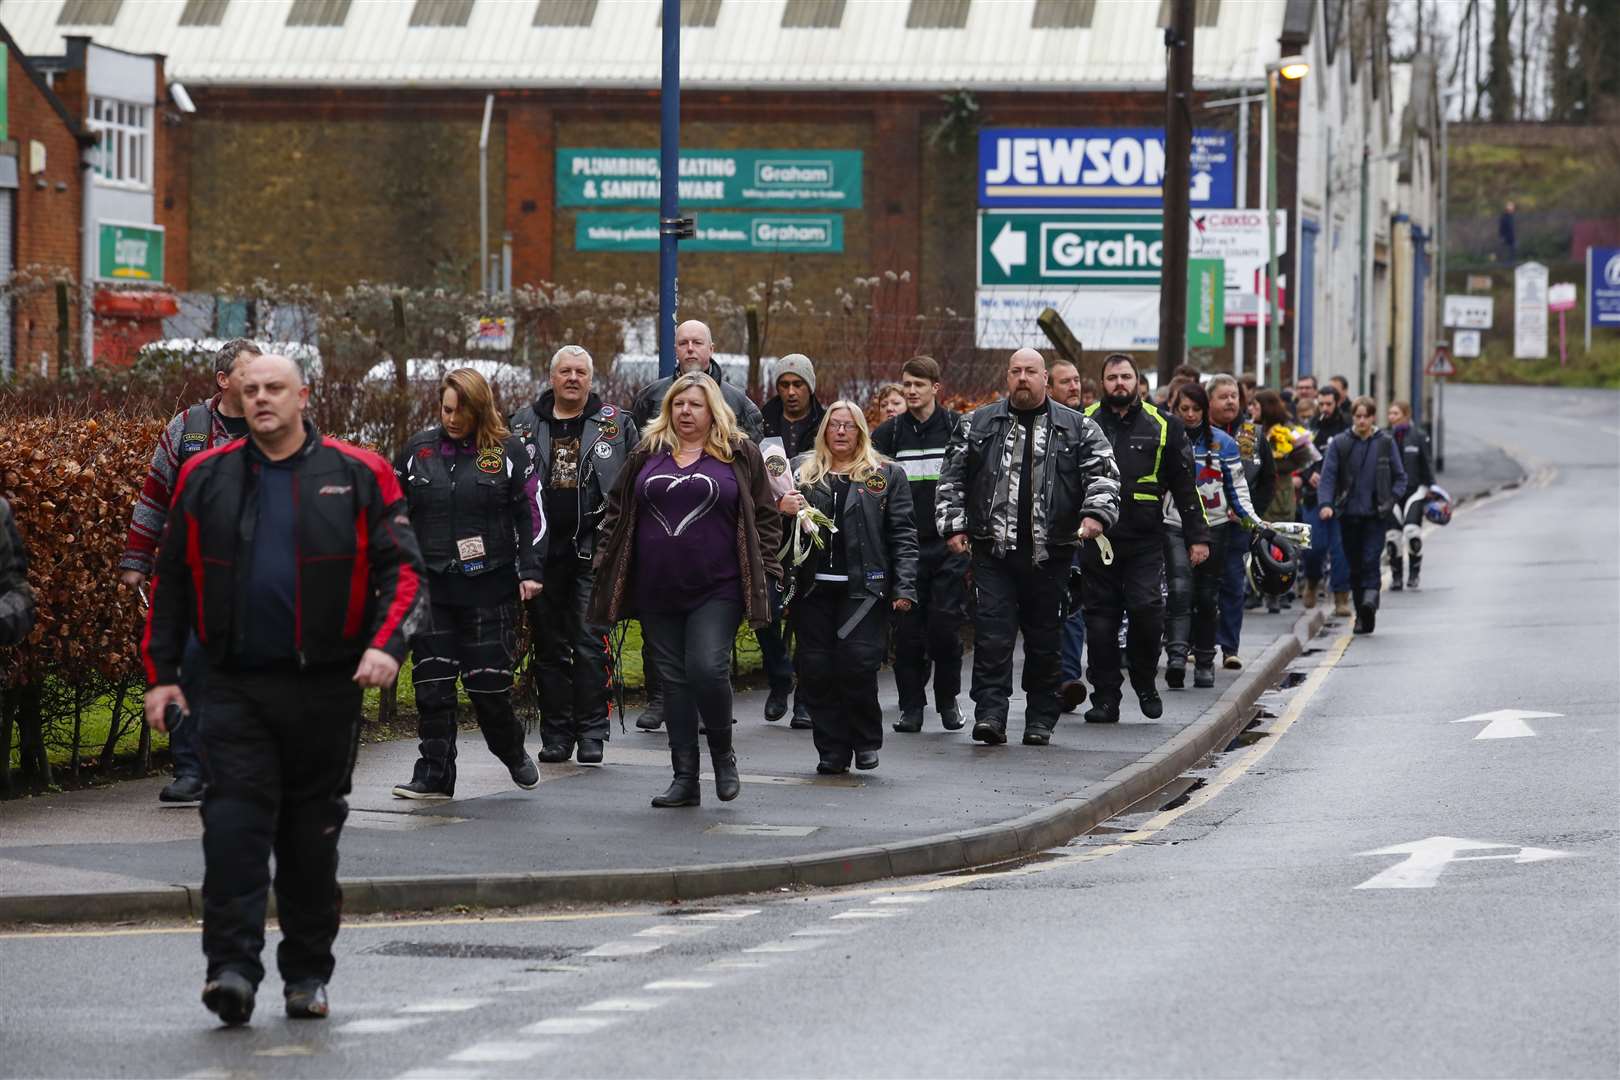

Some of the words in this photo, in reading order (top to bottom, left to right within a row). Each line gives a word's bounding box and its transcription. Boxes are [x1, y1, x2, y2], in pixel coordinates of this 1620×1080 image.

[678, 158, 736, 176] EATING
[761, 166, 828, 182] Graham
[583, 179, 597, 198] &
[758, 224, 825, 241] Graham
[1053, 232, 1163, 267] Graha
